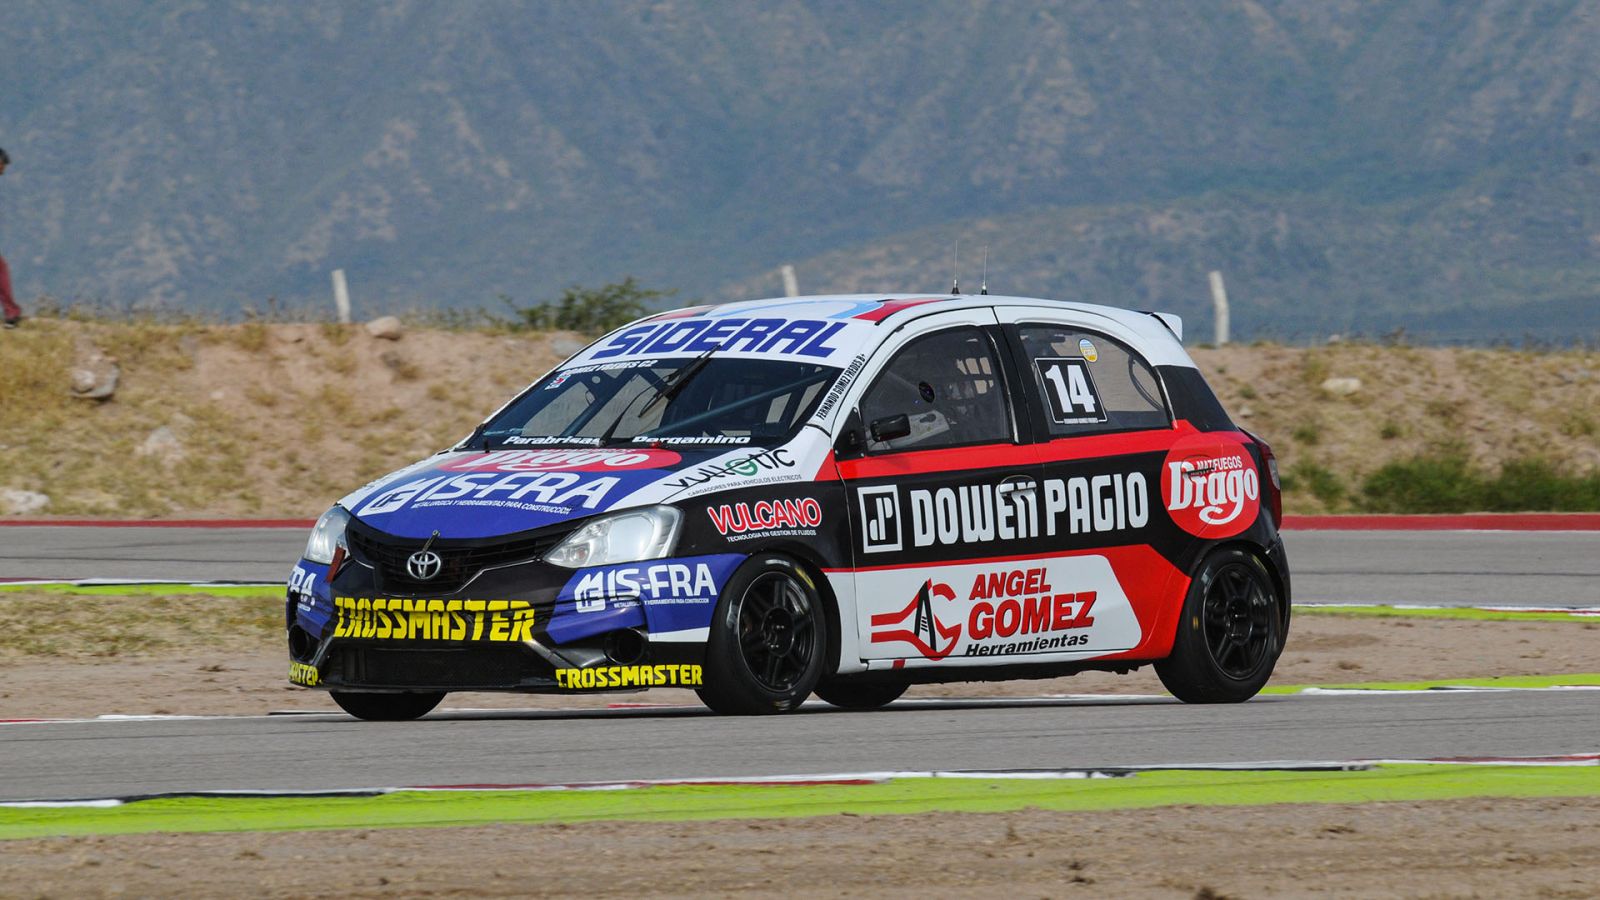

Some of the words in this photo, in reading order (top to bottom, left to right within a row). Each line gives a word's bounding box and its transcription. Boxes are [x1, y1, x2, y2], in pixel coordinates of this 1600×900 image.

[589, 318, 849, 359] SIDERAL
[816, 392, 839, 420] FERNANDO
[833, 375, 851, 395] GOMEZ
[844, 359, 863, 379] FREDES
[1045, 365, 1096, 413] 14
[726, 481, 742, 489] PARA
[742, 477, 771, 486] VEHICULOS
[771, 474, 802, 483] ELECTRICOS
[1168, 461, 1259, 525] Drago
[707, 497, 822, 535] VULCANO
[910, 480, 1039, 547] DOWEN
[1044, 471, 1149, 536] PAGIO
[726, 532, 762, 543] TECNOLOGIA
[969, 568, 1051, 600] ANGEL
[968, 591, 1097, 640] GOMEZ
[965, 632, 1089, 657] Herramientas
[555, 664, 703, 689] CROSSMASTER
